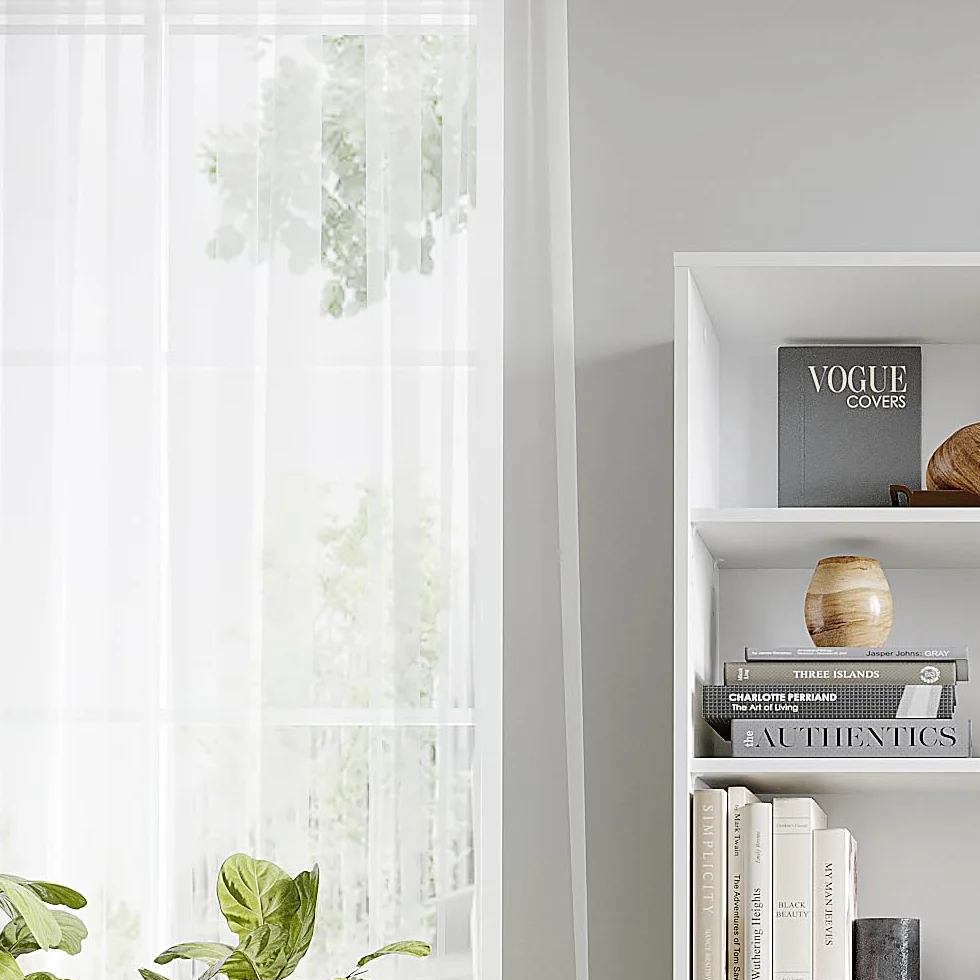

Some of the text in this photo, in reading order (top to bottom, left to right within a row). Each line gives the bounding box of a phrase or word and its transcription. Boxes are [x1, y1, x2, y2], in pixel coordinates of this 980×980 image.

[807, 365, 908, 393] VOGUE
[846, 395, 906, 409] COVERS
[866, 650, 894, 658] Jasper
[792, 670, 880, 679] THREE ISLANDS
[728, 692, 838, 702] CHARLOTTE PERRIAND
[732, 703, 799, 713] The Art of Living
[743, 730, 754, 748] the
[755, 726, 957, 748] AUTHENTICS
[733, 813, 741, 833] Mark
[733, 834, 741, 857] Twain
[702, 804, 715, 914] SIMPLICITY
[733, 874, 741, 889] The
[733, 890, 741, 936] Adventures
[778, 901, 806, 909] BLACK
[824, 862, 833, 947] MY MAN JEEVES
[733, 937, 741, 947] of
[751, 887, 763, 980] Wuthering Heights
[733, 947, 741, 965] Tom
